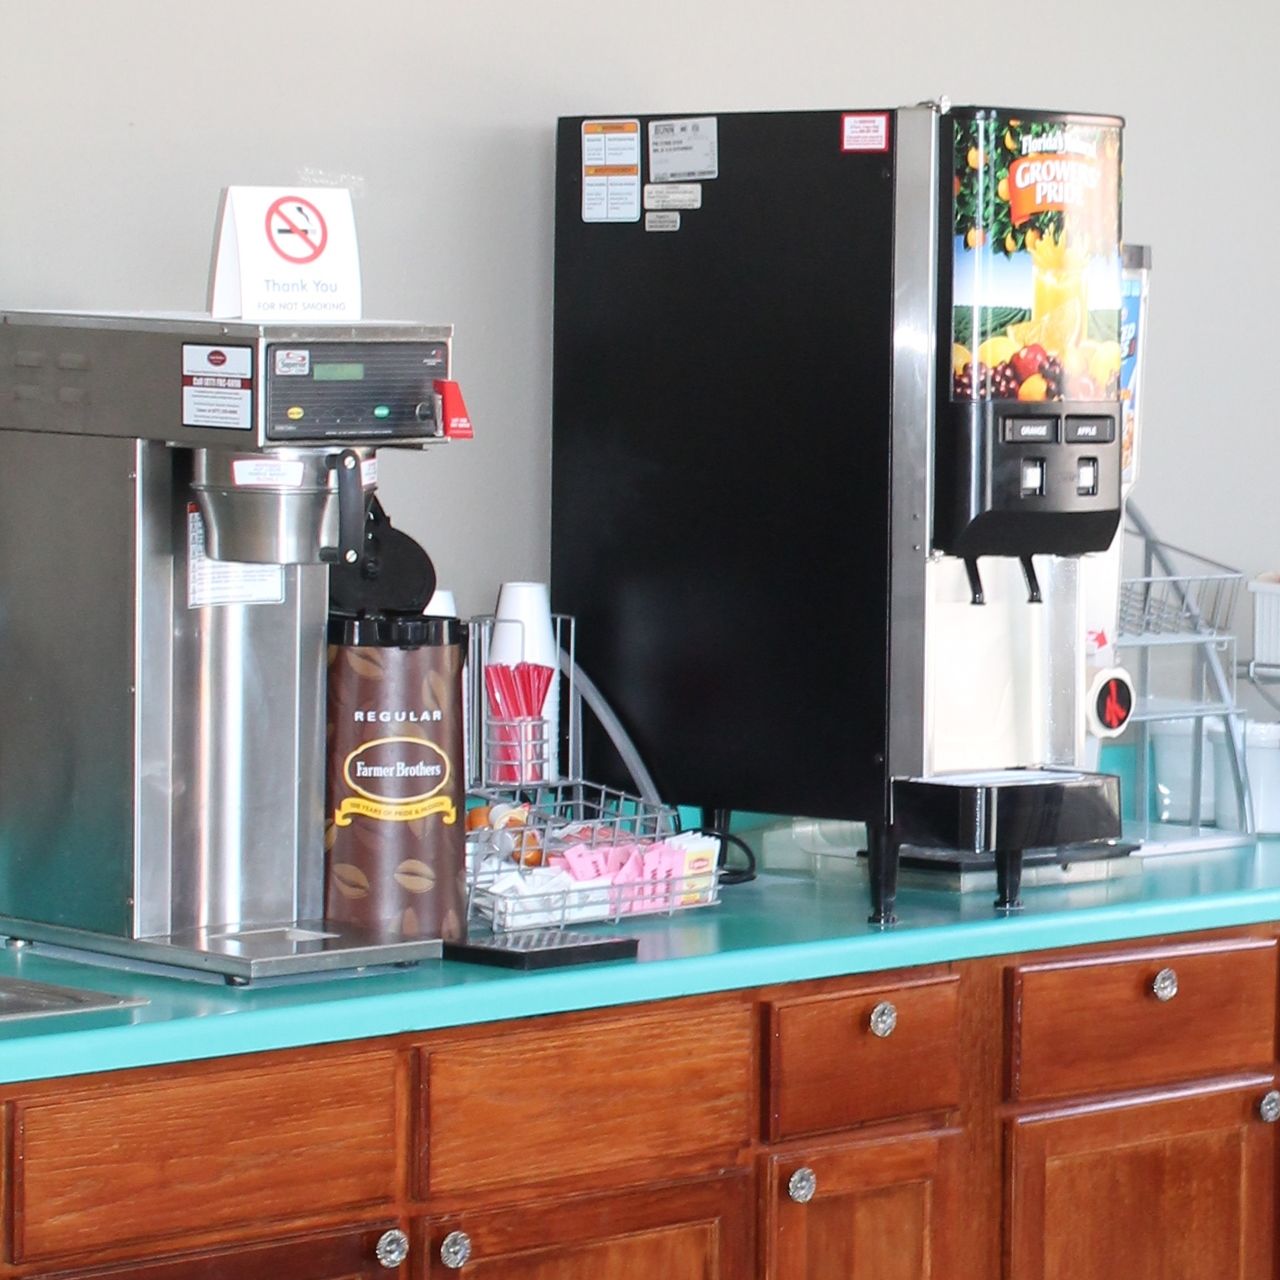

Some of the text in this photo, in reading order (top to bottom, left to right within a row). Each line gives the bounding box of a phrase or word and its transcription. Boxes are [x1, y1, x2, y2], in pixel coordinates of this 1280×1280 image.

[264, 278, 338, 293] Thank You
[257, 301, 346, 312] FOR NOT SMOKING
[1020, 424, 1048, 436] ORANGE
[1076, 425, 1097, 436] APPLE
[353, 710, 442, 722] REGULAR
[355, 759, 442, 777] Farmer Brothers
[361, 805, 382, 816] YEARS
